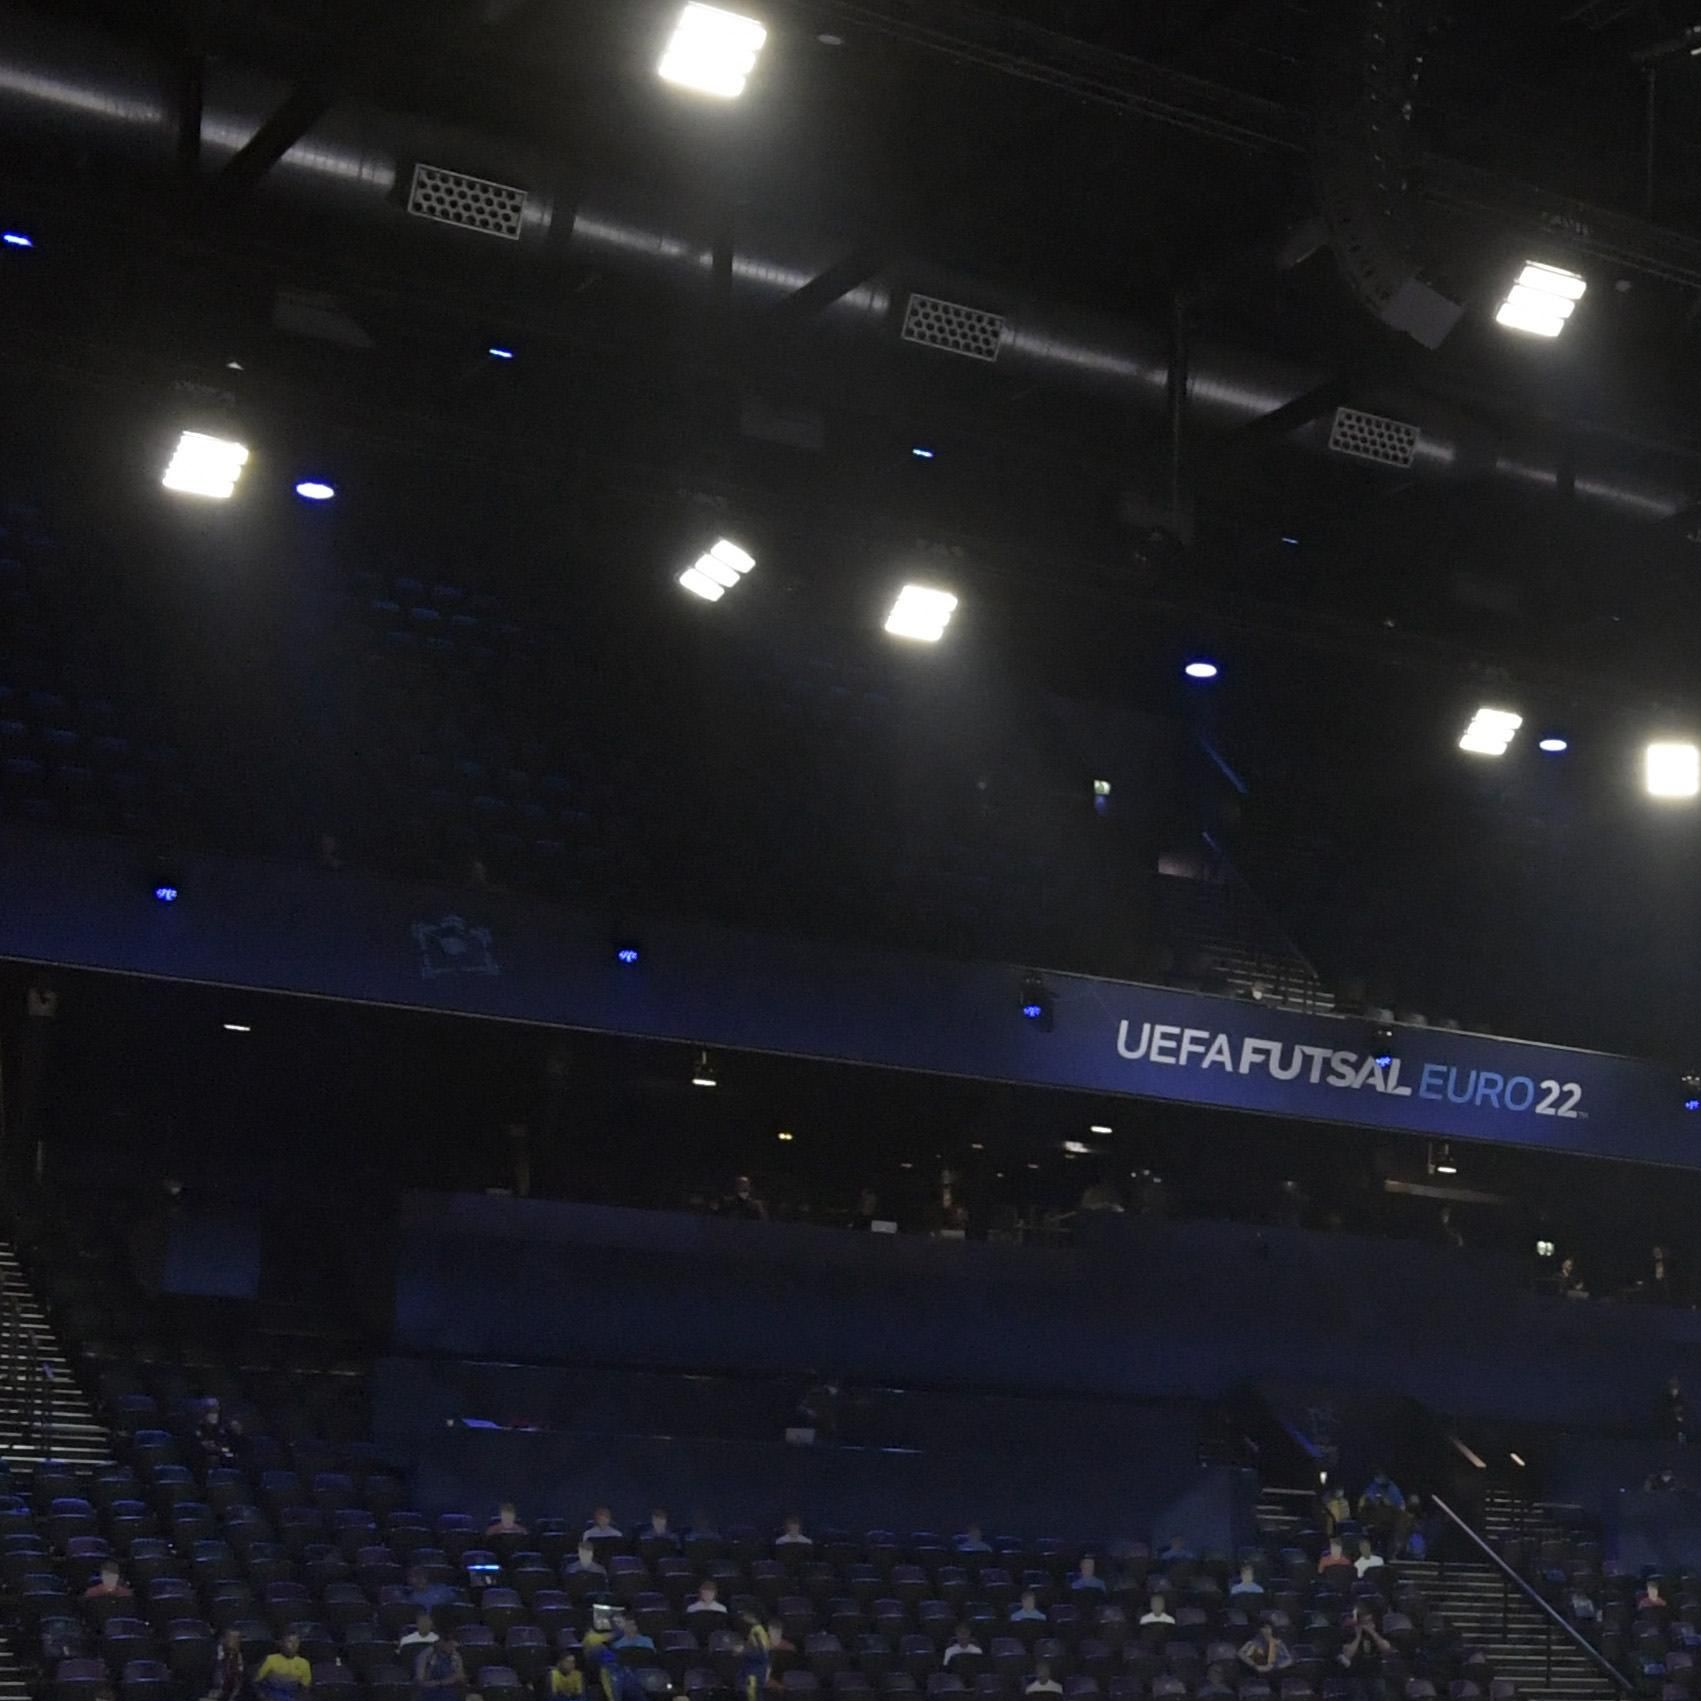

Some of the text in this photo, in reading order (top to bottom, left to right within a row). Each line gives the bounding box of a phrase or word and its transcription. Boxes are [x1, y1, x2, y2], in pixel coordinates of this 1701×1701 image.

[1116, 1019, 1233, 1072] UEFA
[1239, 1037, 1412, 1097] FUTSAL
[1419, 1062, 1534, 1111] EURO
